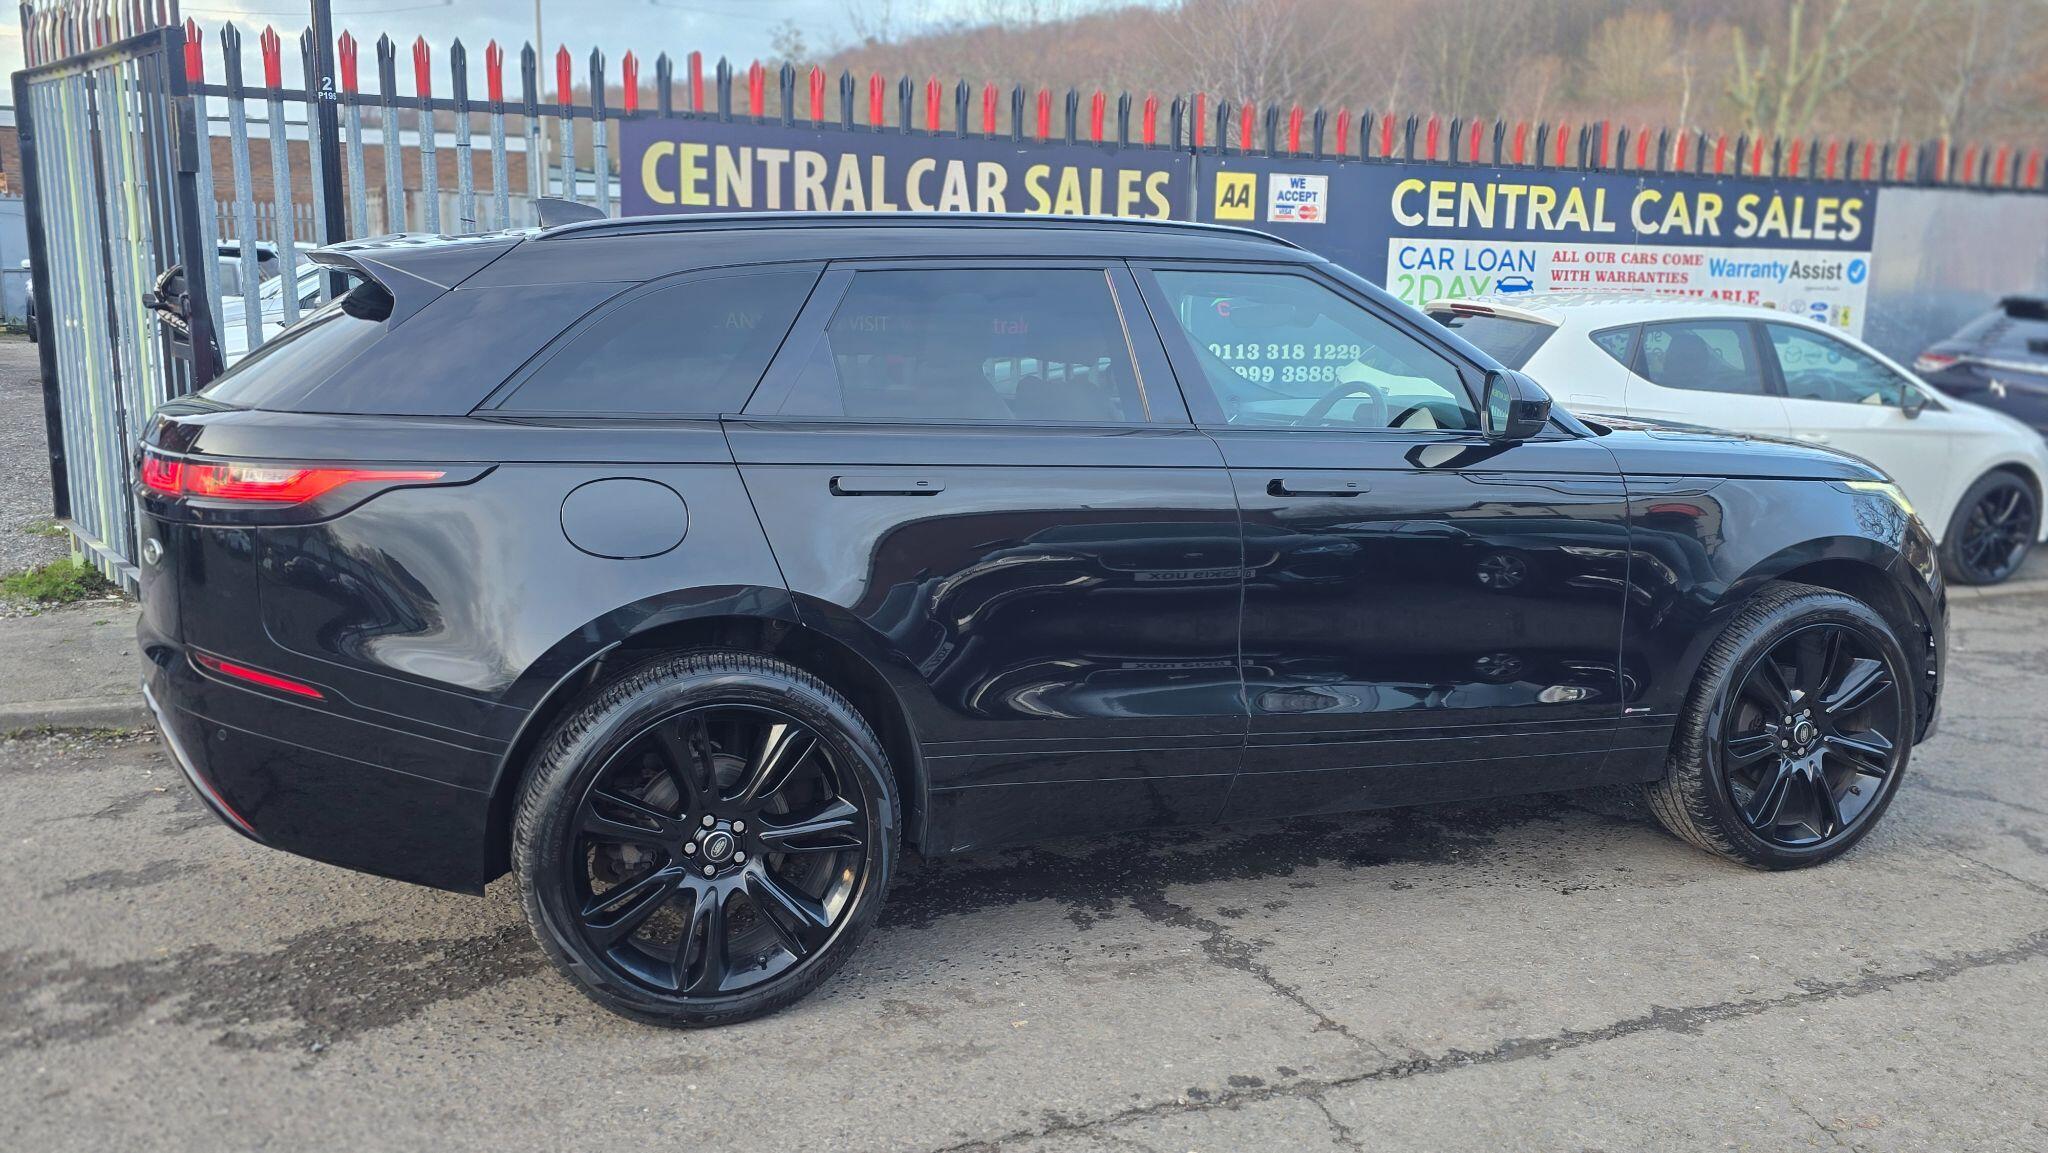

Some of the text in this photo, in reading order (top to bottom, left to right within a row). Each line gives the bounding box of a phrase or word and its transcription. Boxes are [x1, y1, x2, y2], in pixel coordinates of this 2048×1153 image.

[322, 76, 332, 90] 2
[641, 140, 1171, 221] CENTRAL CAR SALES
[1290, 177, 1306, 189] WE
[1220, 183, 1250, 208] AA
[1277, 190, 1318, 202] ACCEPT
[1391, 178, 1864, 242] CENTRAL CAR SALES
[1399, 246, 1537, 273] CAR LOAN
[1552, 250, 1704, 267] ALL OUR CARS COME
[1551, 269, 1689, 285] WITH WARRANTIES
[1397, 273, 1492, 306] 2DAY
[1266, 344, 1305, 360] 318
